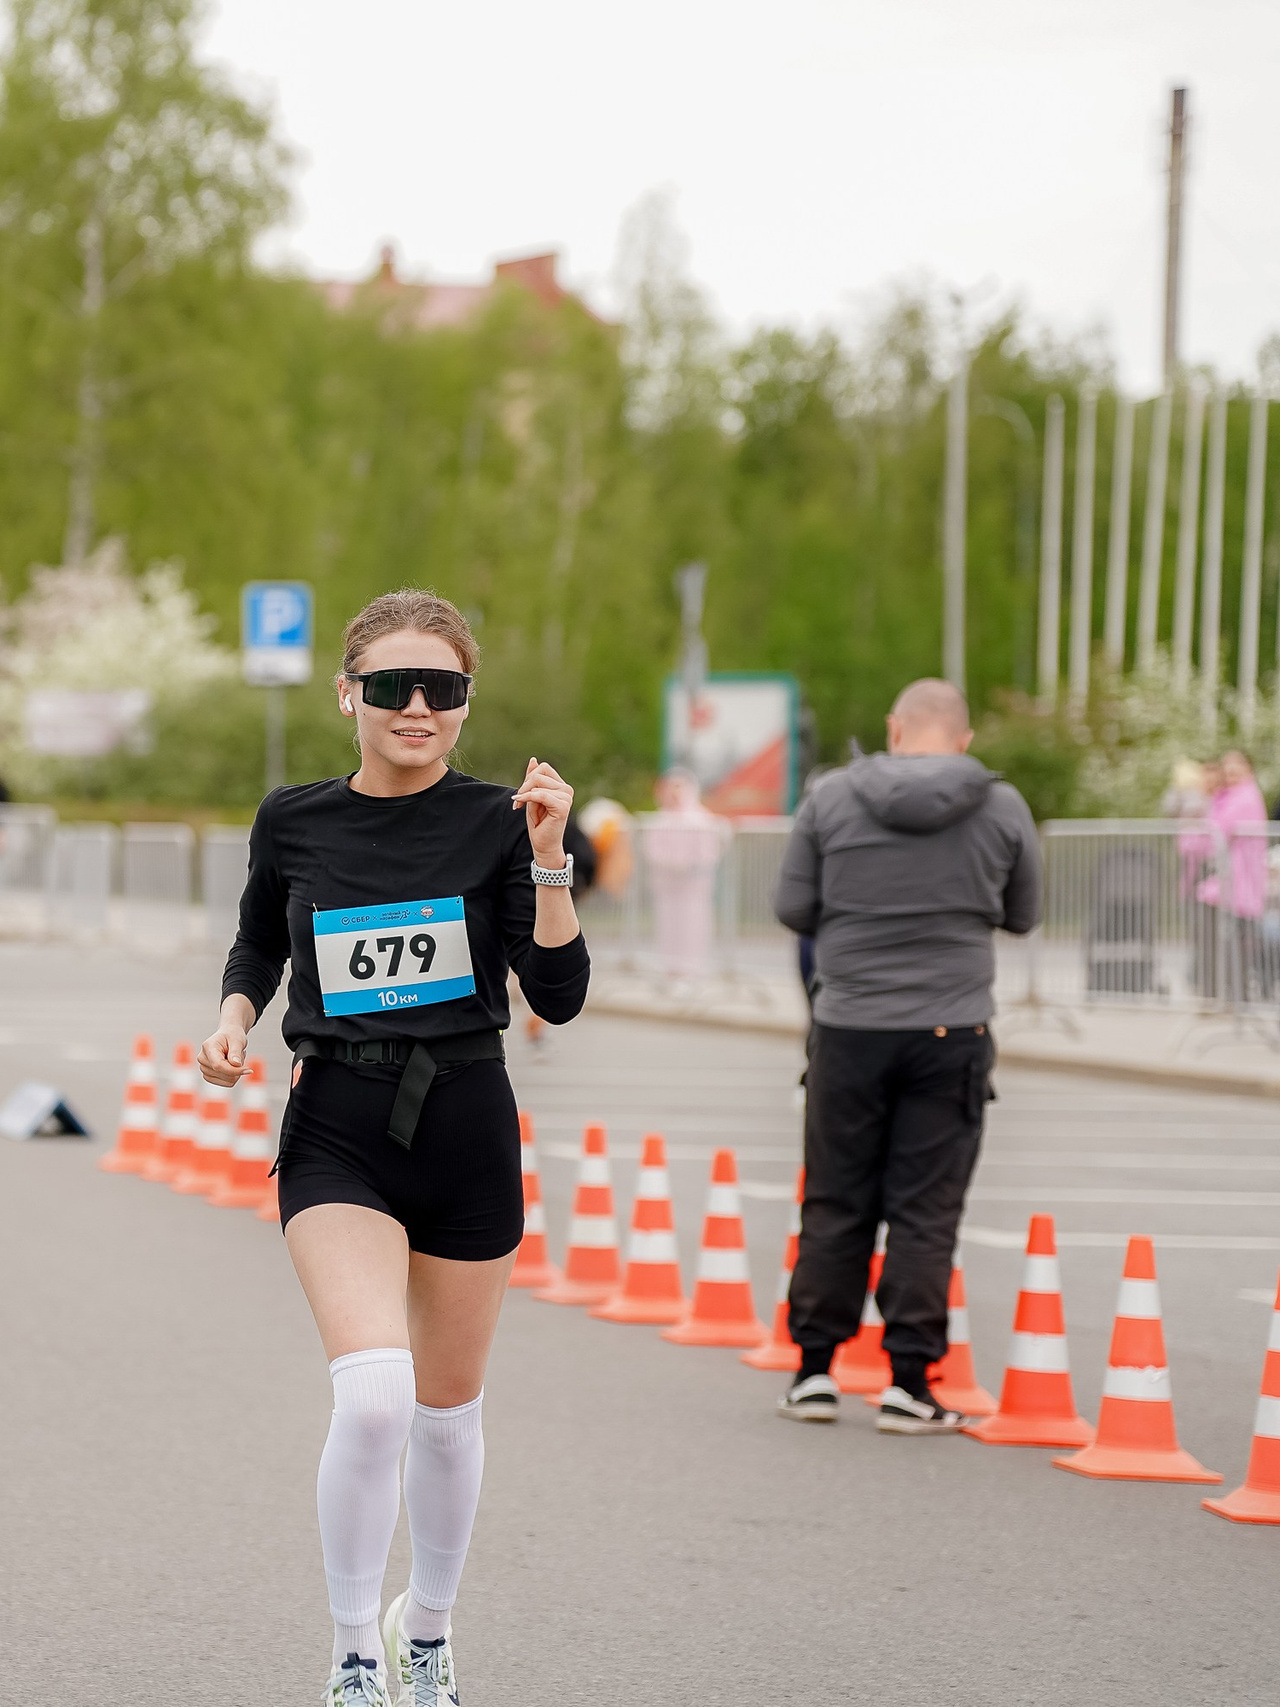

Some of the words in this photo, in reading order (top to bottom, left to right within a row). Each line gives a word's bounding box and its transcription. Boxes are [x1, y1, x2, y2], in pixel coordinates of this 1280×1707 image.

[351, 915, 370, 924] СБЕР
[349, 933, 437, 980] 679
[377, 990, 398, 1007] 10
